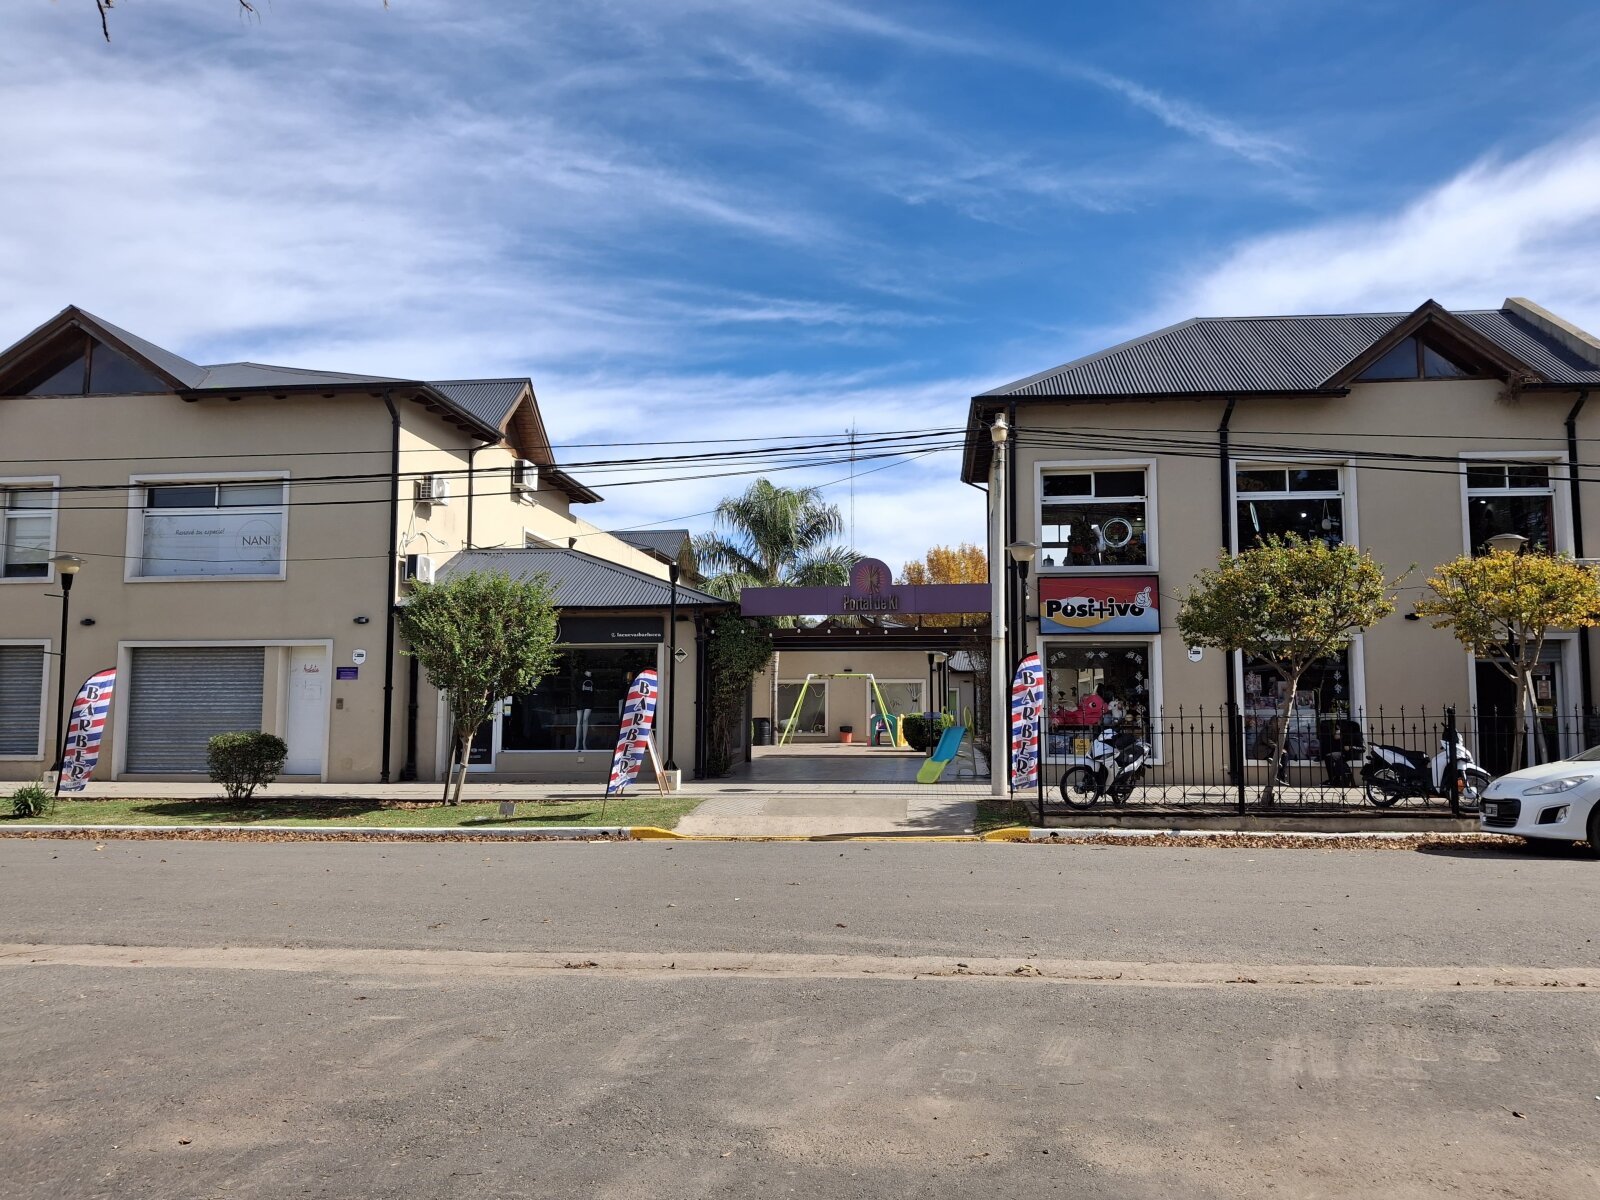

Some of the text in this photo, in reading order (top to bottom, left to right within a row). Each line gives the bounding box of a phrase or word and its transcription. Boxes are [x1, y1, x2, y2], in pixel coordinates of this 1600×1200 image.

[242, 535, 271, 546] NANI
[843, 594, 873, 611] Portal
[874, 595, 887, 610] de
[1046, 597, 1145, 619] Positivo
[70, 686, 99, 780] BARBER
[619, 681, 650, 774] BARBER
[1016, 671, 1036, 775] BARBER
